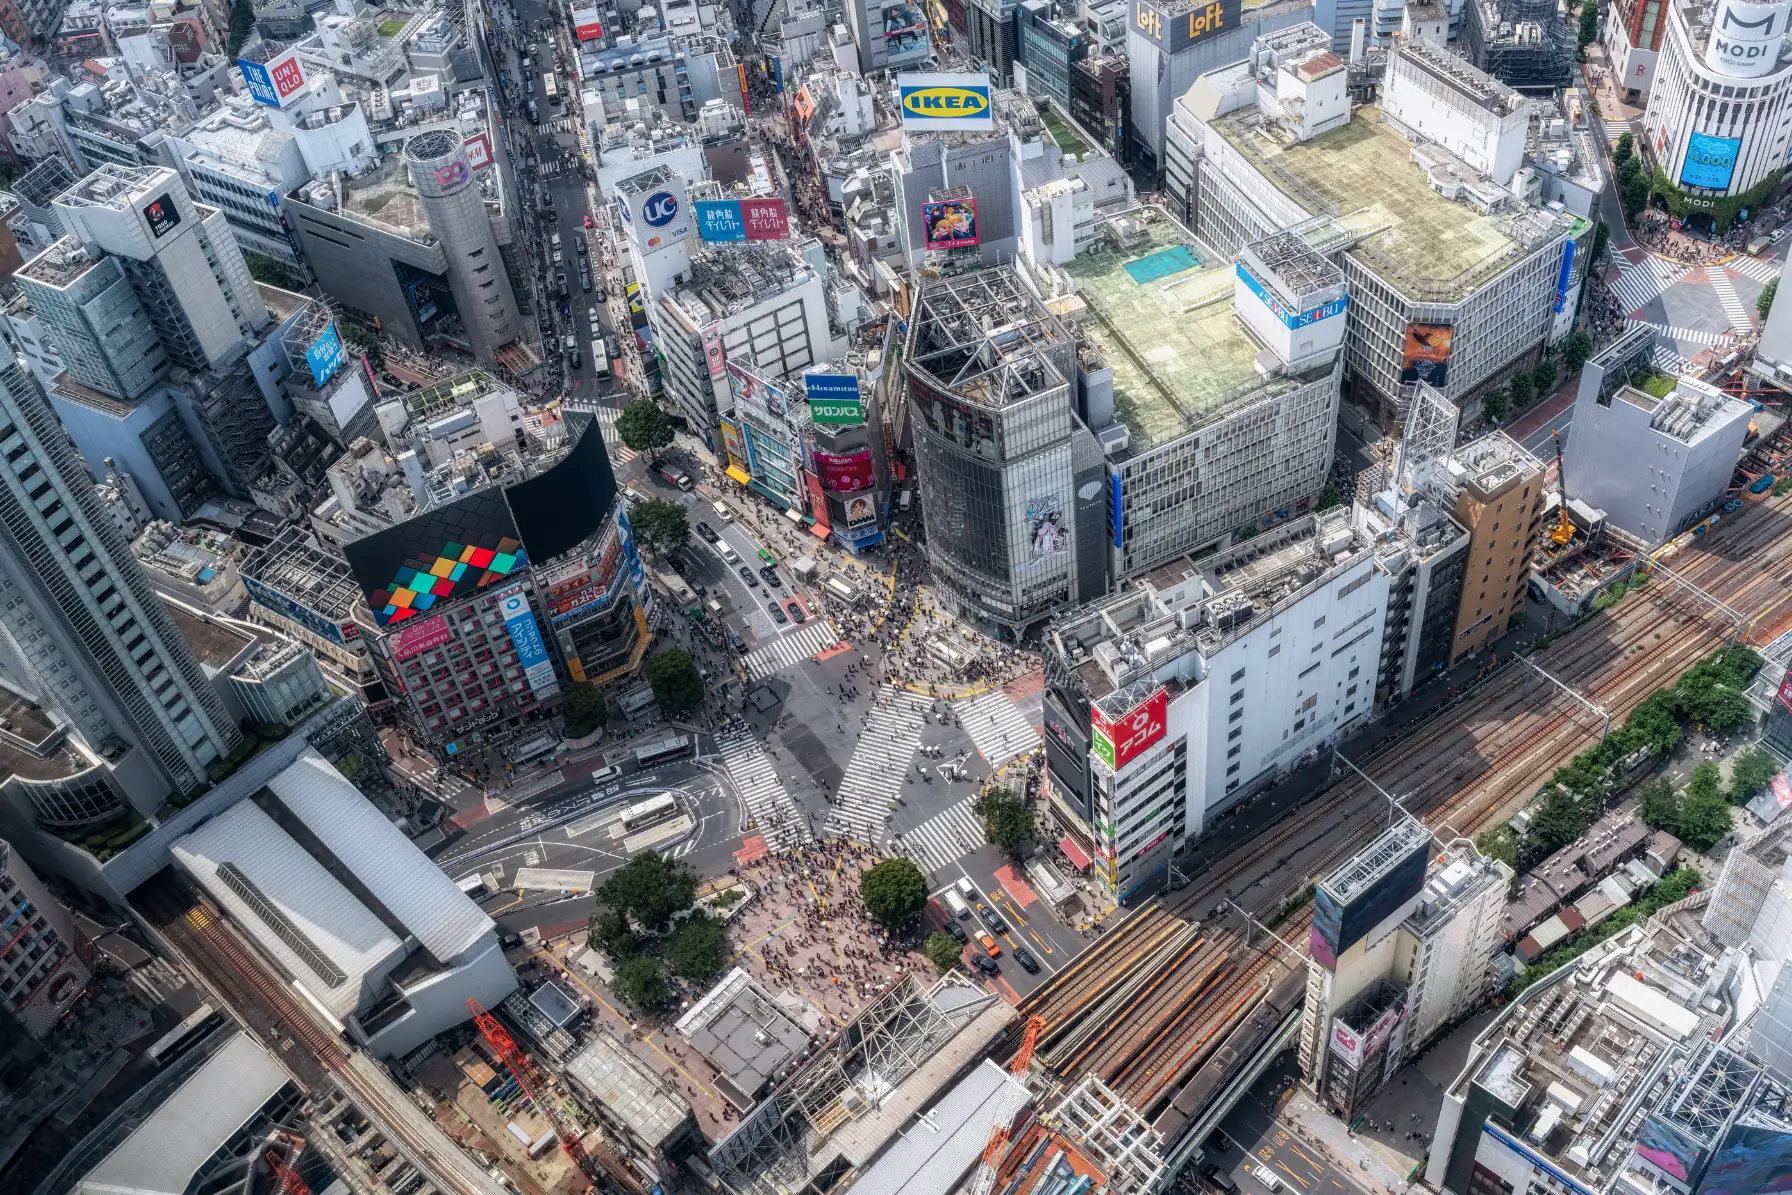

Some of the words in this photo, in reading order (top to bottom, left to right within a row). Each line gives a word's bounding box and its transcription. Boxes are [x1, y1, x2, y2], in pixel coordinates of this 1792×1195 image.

[1716, 38, 1767, 58] MODI
[246, 65, 265, 84] THE
[275, 62, 295, 81] UNI
[248, 80, 277, 102] PRIME
[280, 74, 300, 92] QLO
[910, 95, 982, 109] IKEA
[644, 197, 676, 222] UC
[1683, 196, 1715, 208] MODI
[671, 226, 688, 238] VISA
[1299, 303, 1339, 326] SEIBU
[810, 384, 858, 392] Hisamitsu
[813, 405, 860, 417] サロンパス
[1119, 720, 1161, 757] アコム
